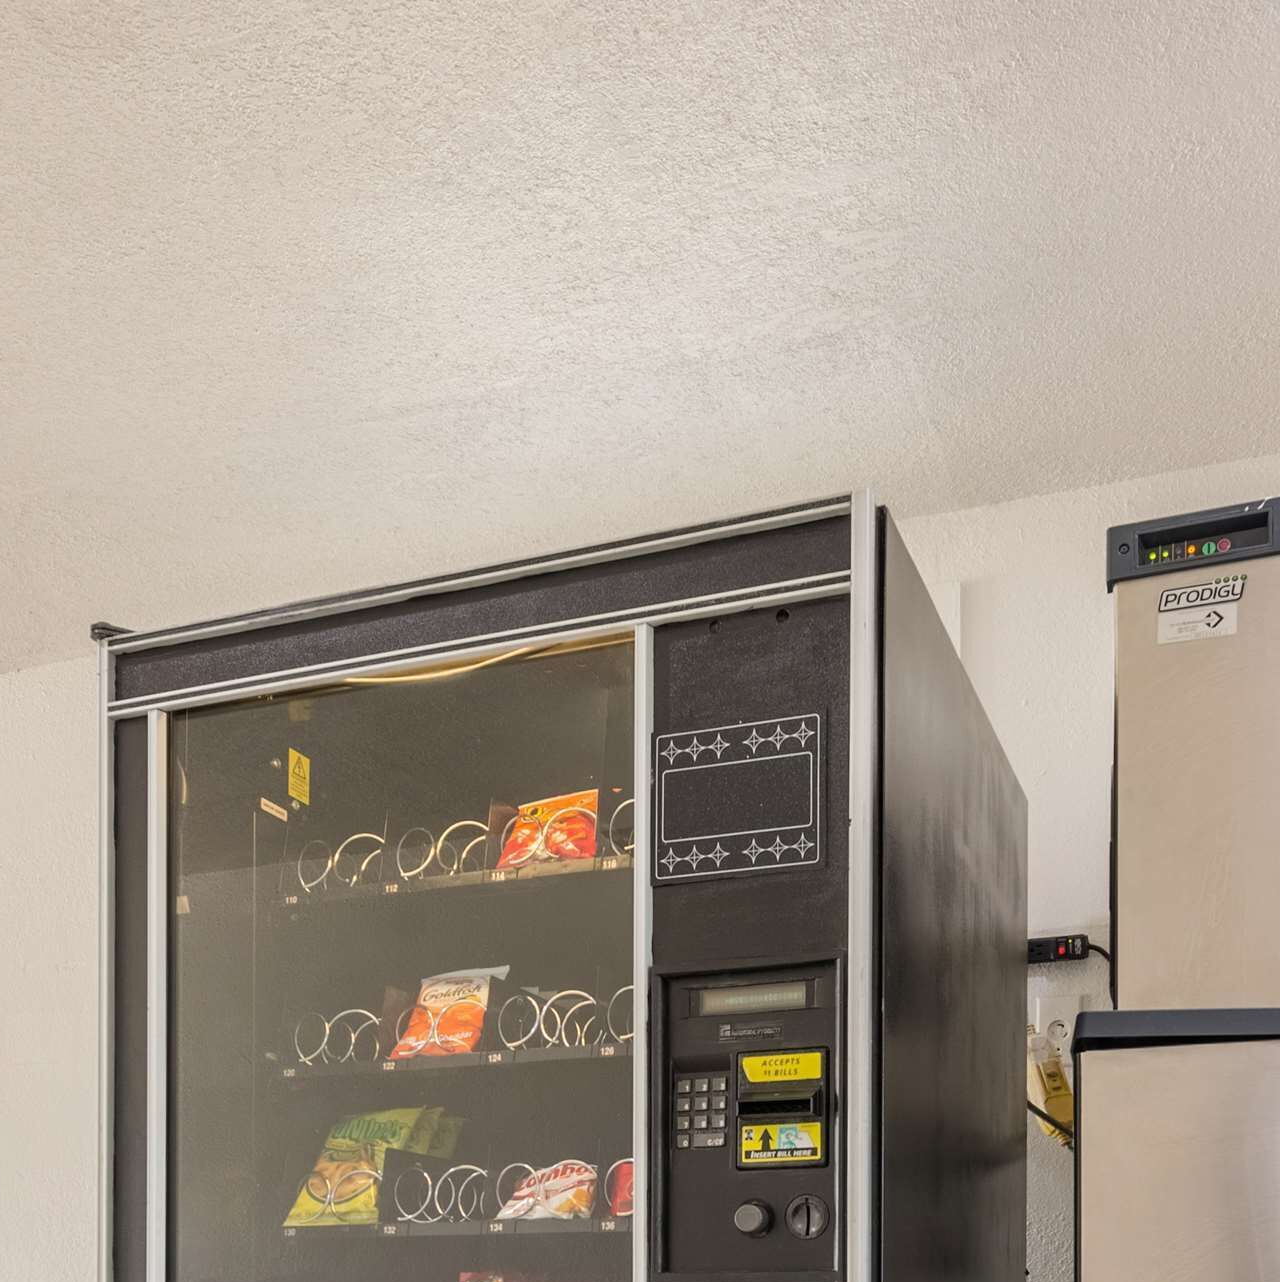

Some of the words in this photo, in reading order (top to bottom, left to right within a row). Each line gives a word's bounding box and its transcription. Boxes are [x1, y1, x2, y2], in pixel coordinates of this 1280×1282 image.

[423, 982, 481, 1002] Goldfish
[761, 1056, 801, 1067] ACCEPTS
[774, 1069, 799, 1077] BILLS
[750, 1151, 776, 1159] INSERT
[776, 1150, 792, 1158] BILL
[793, 1148, 813, 1157] HERE
[489, 1223, 503, 1232] 134
